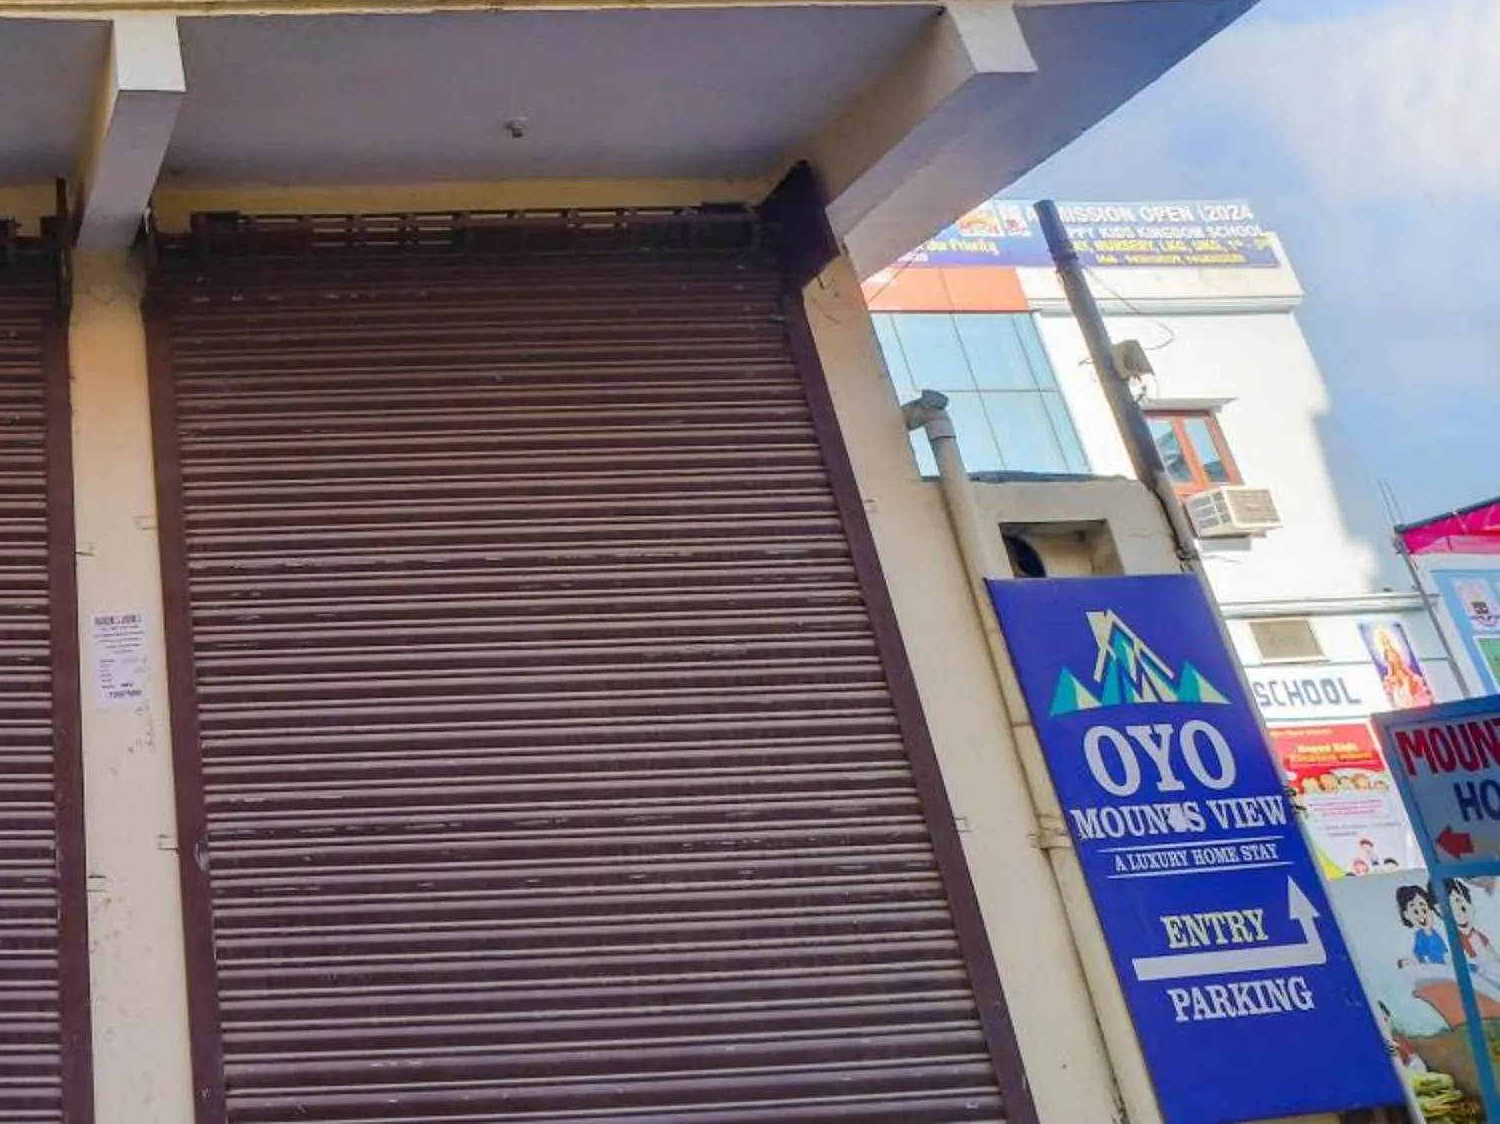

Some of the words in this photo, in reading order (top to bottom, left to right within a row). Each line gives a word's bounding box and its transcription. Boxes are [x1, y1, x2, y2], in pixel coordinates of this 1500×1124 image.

[1025, 204, 1134, 224] AMISSION
[1138, 205, 1195, 224] OPEN
[1252, 677, 1362, 707] SCHOOL
[1083, 720, 1237, 797] OYO
[1395, 718, 1500, 776] MOUN
[1205, 795, 1287, 830] VIEW
[1115, 854, 1128, 872] A
[1127, 850, 1190, 871] LUXURY
[1190, 846, 1241, 865] HOME
[1240, 843, 1280, 861] STAY
[1160, 908, 1269, 949] ENTRY
[1167, 976, 1315, 1022] PARKING
